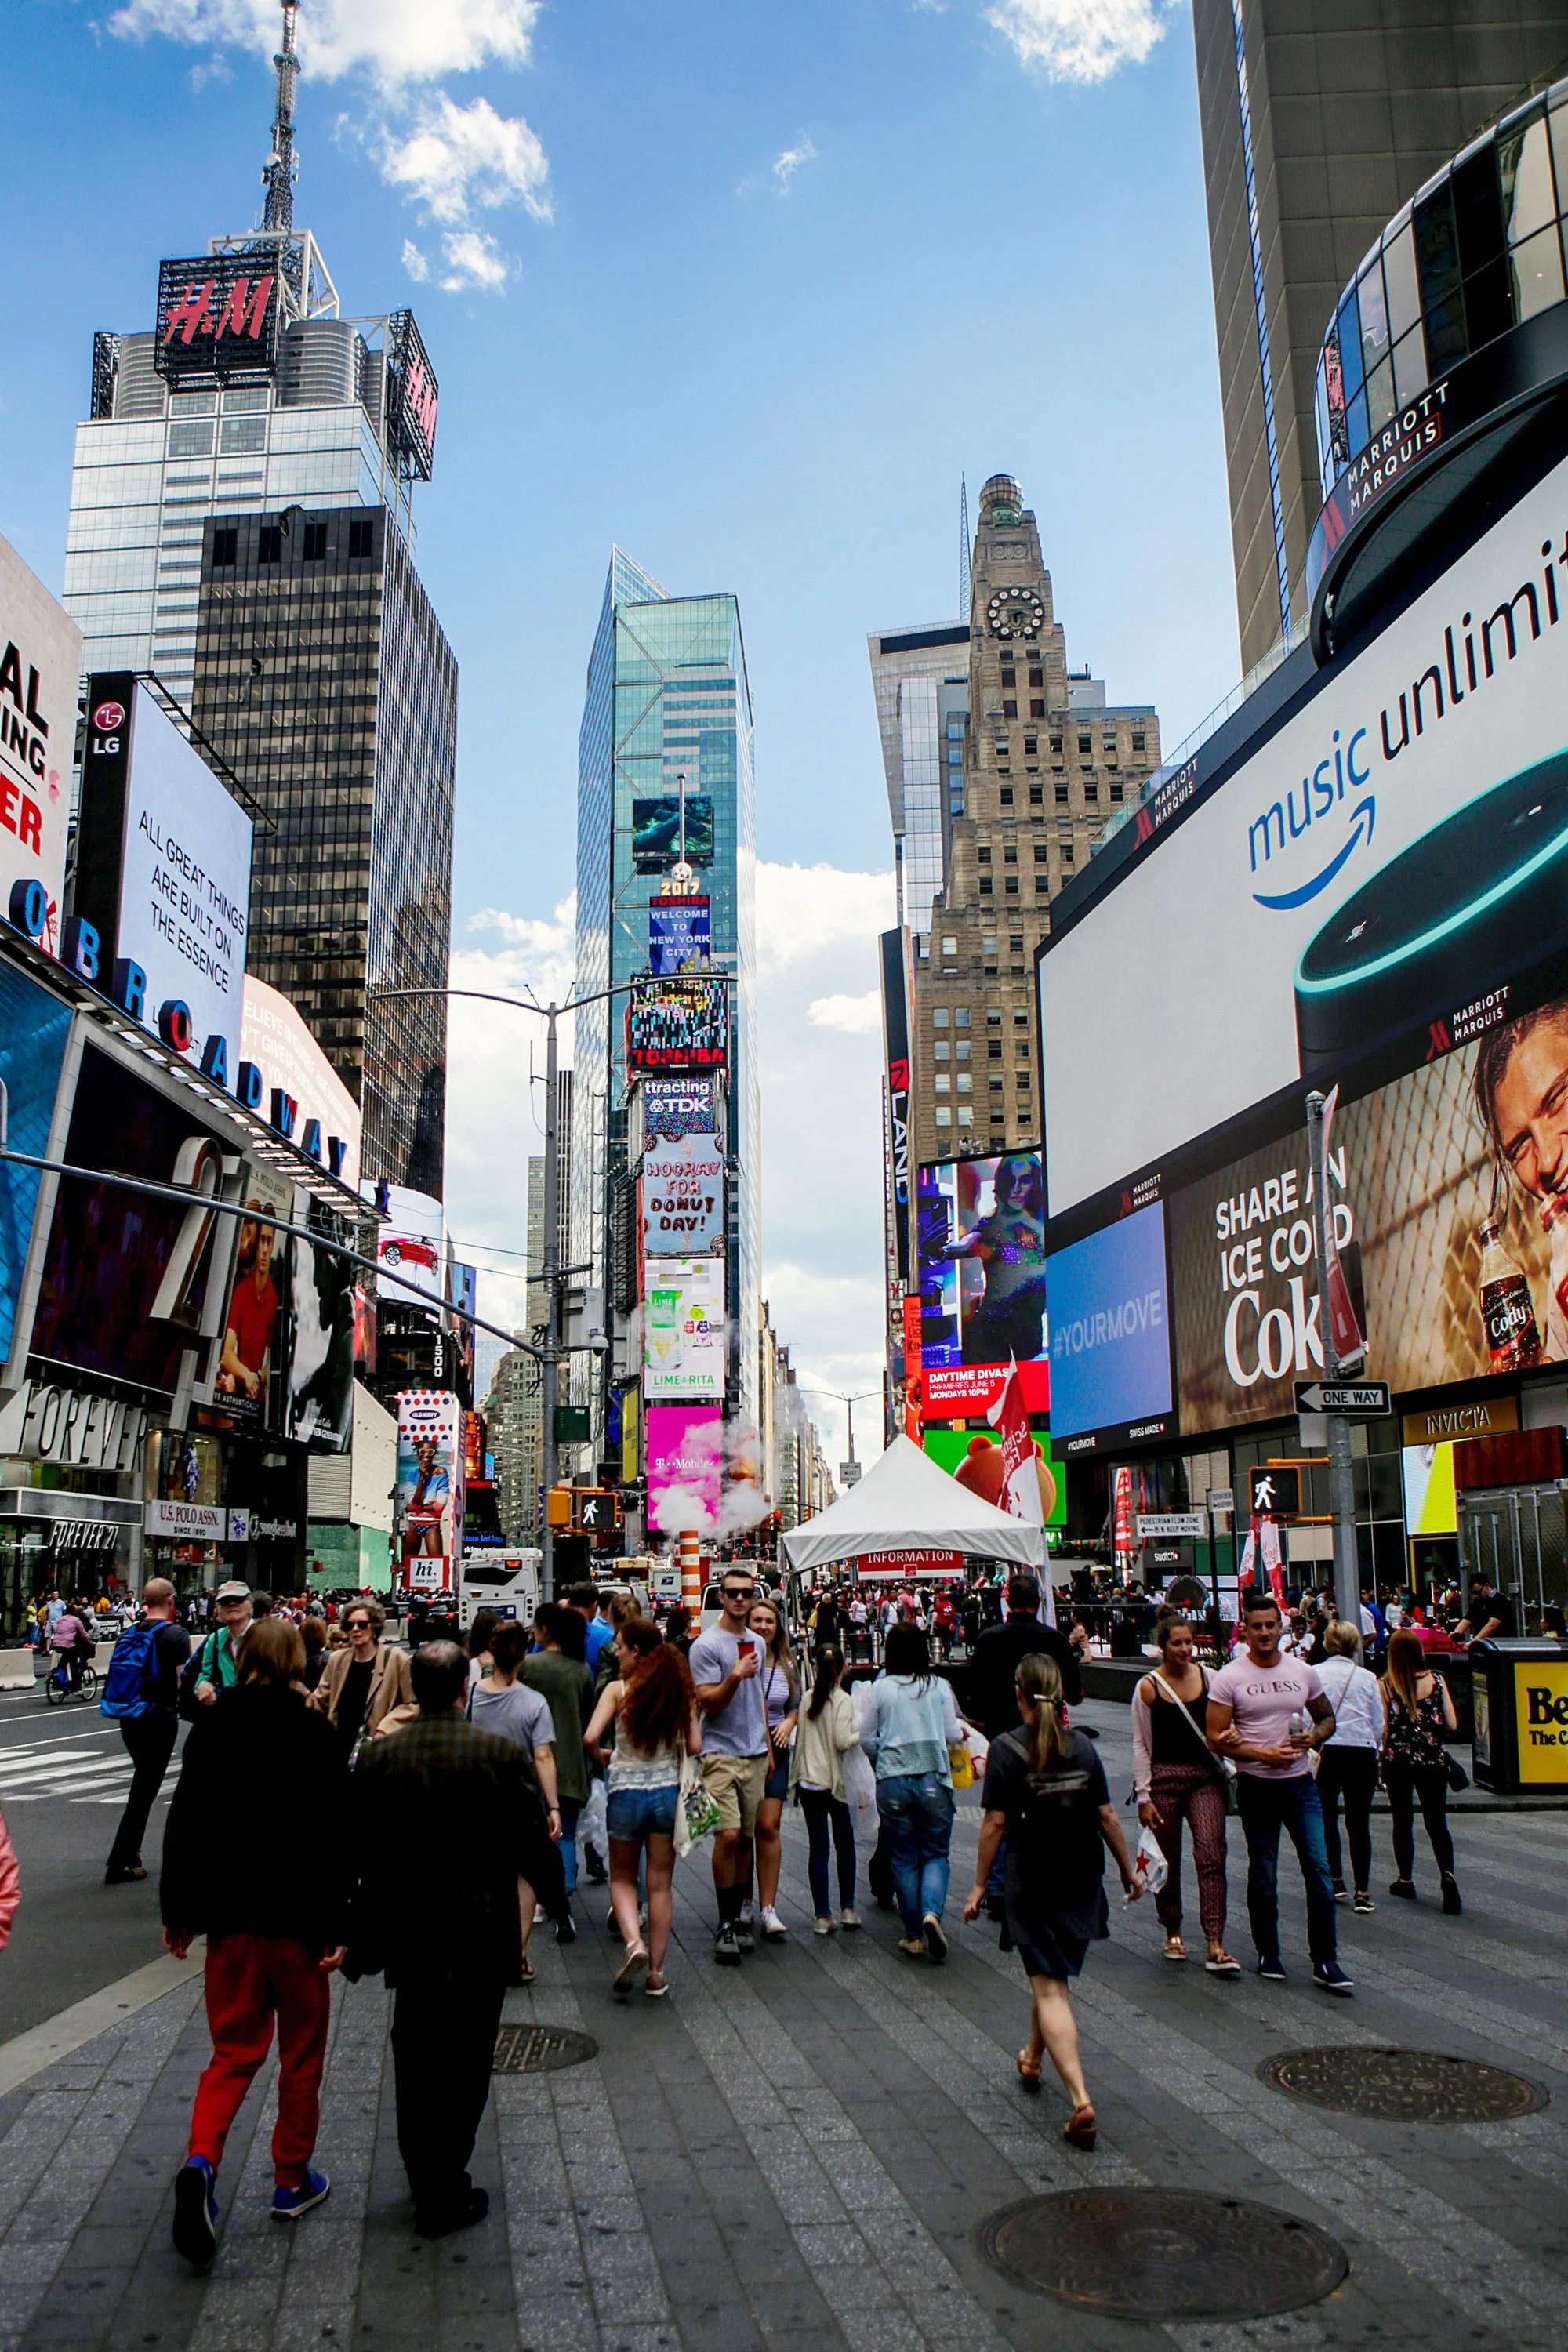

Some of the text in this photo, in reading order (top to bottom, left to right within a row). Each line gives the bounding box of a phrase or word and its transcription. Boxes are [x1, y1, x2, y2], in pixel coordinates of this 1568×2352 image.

[164, 275, 274, 344] H&M
[1347, 381, 1450, 491] MARRIOTT
[1348, 420, 1439, 517] MARQUIS
[93, 737, 120, 755] LG
[1154, 757, 1198, 810] MARRIOTT
[1155, 780, 1195, 827] MARQUIS
[1248, 727, 1370, 872] music
[139, 809, 245, 936] ALL GREAT THINGS
[660, 881, 700, 896] 2017
[650, 896, 709, 906] TOSHIBA
[151, 865, 232, 960] ARE BUILT ON
[650, 909, 709, 920] WELCOME
[672, 922, 688, 931] TO
[151, 901, 228, 994] THE ESSENCE
[649, 934, 711, 945] NEW YORK
[666, 947, 694, 957] CITY
[1452, 985, 1509, 1025] MARRIOTT
[1454, 1007, 1504, 1041] MARQUIS
[63, 916, 348, 1178] BROADWAY
[632, 1048, 725, 1064] TOSHIBA
[644, 1081, 710, 1095] ttracting
[665, 1098, 710, 1112] TDK
[646, 1160, 721, 1177] HOORAY
[666, 1179, 702, 1196] FOR
[1133, 1173, 1161, 1196] MARRIOTT
[650, 1196, 715, 1214] DONUT
[1133, 1187, 1159, 1207] MARQUIS
[1216, 1168, 1298, 1240] SHARE
[659, 1215, 706, 1232] DAY!
[1221, 1236, 1264, 1292] ICE
[1053, 1289, 1163, 1360] #YOURMOVE
[1490, 1305, 1526, 1338] Cody
[1224, 1275, 1325, 1387] Cok
[433, 1334, 444, 1377] 1500
[928, 1367, 1010, 1383] DAYTIME DIVAS
[928, 1382, 969, 1392] PREMIERES
[970, 1381, 989, 1389] JUNE
[929, 1388, 989, 1399] MONDAYS 10PM
[1323, 1391, 1379, 1404] ONE WAY
[4, 1378, 149, 1474] FOREVER
[1425, 1406, 1490, 1436] INVICTA
[1128, 1422, 1160, 1439] SWISS MADE
[1067, 1436, 1095, 1451] #YOURMOVE
[160, 1504, 220, 1526] U.S. POLO ASSN.
[49, 1519, 102, 1549] FOREVER
[174, 1526, 206, 1536] SINCE 1890
[867, 1550, 953, 1564] INFORMATION
[1154, 1550, 1174, 1562] swatch
[416, 1561, 437, 1577] hi.
[1246, 1680, 1302, 1697] GUESS
[1528, 1730, 1556, 1747] The
